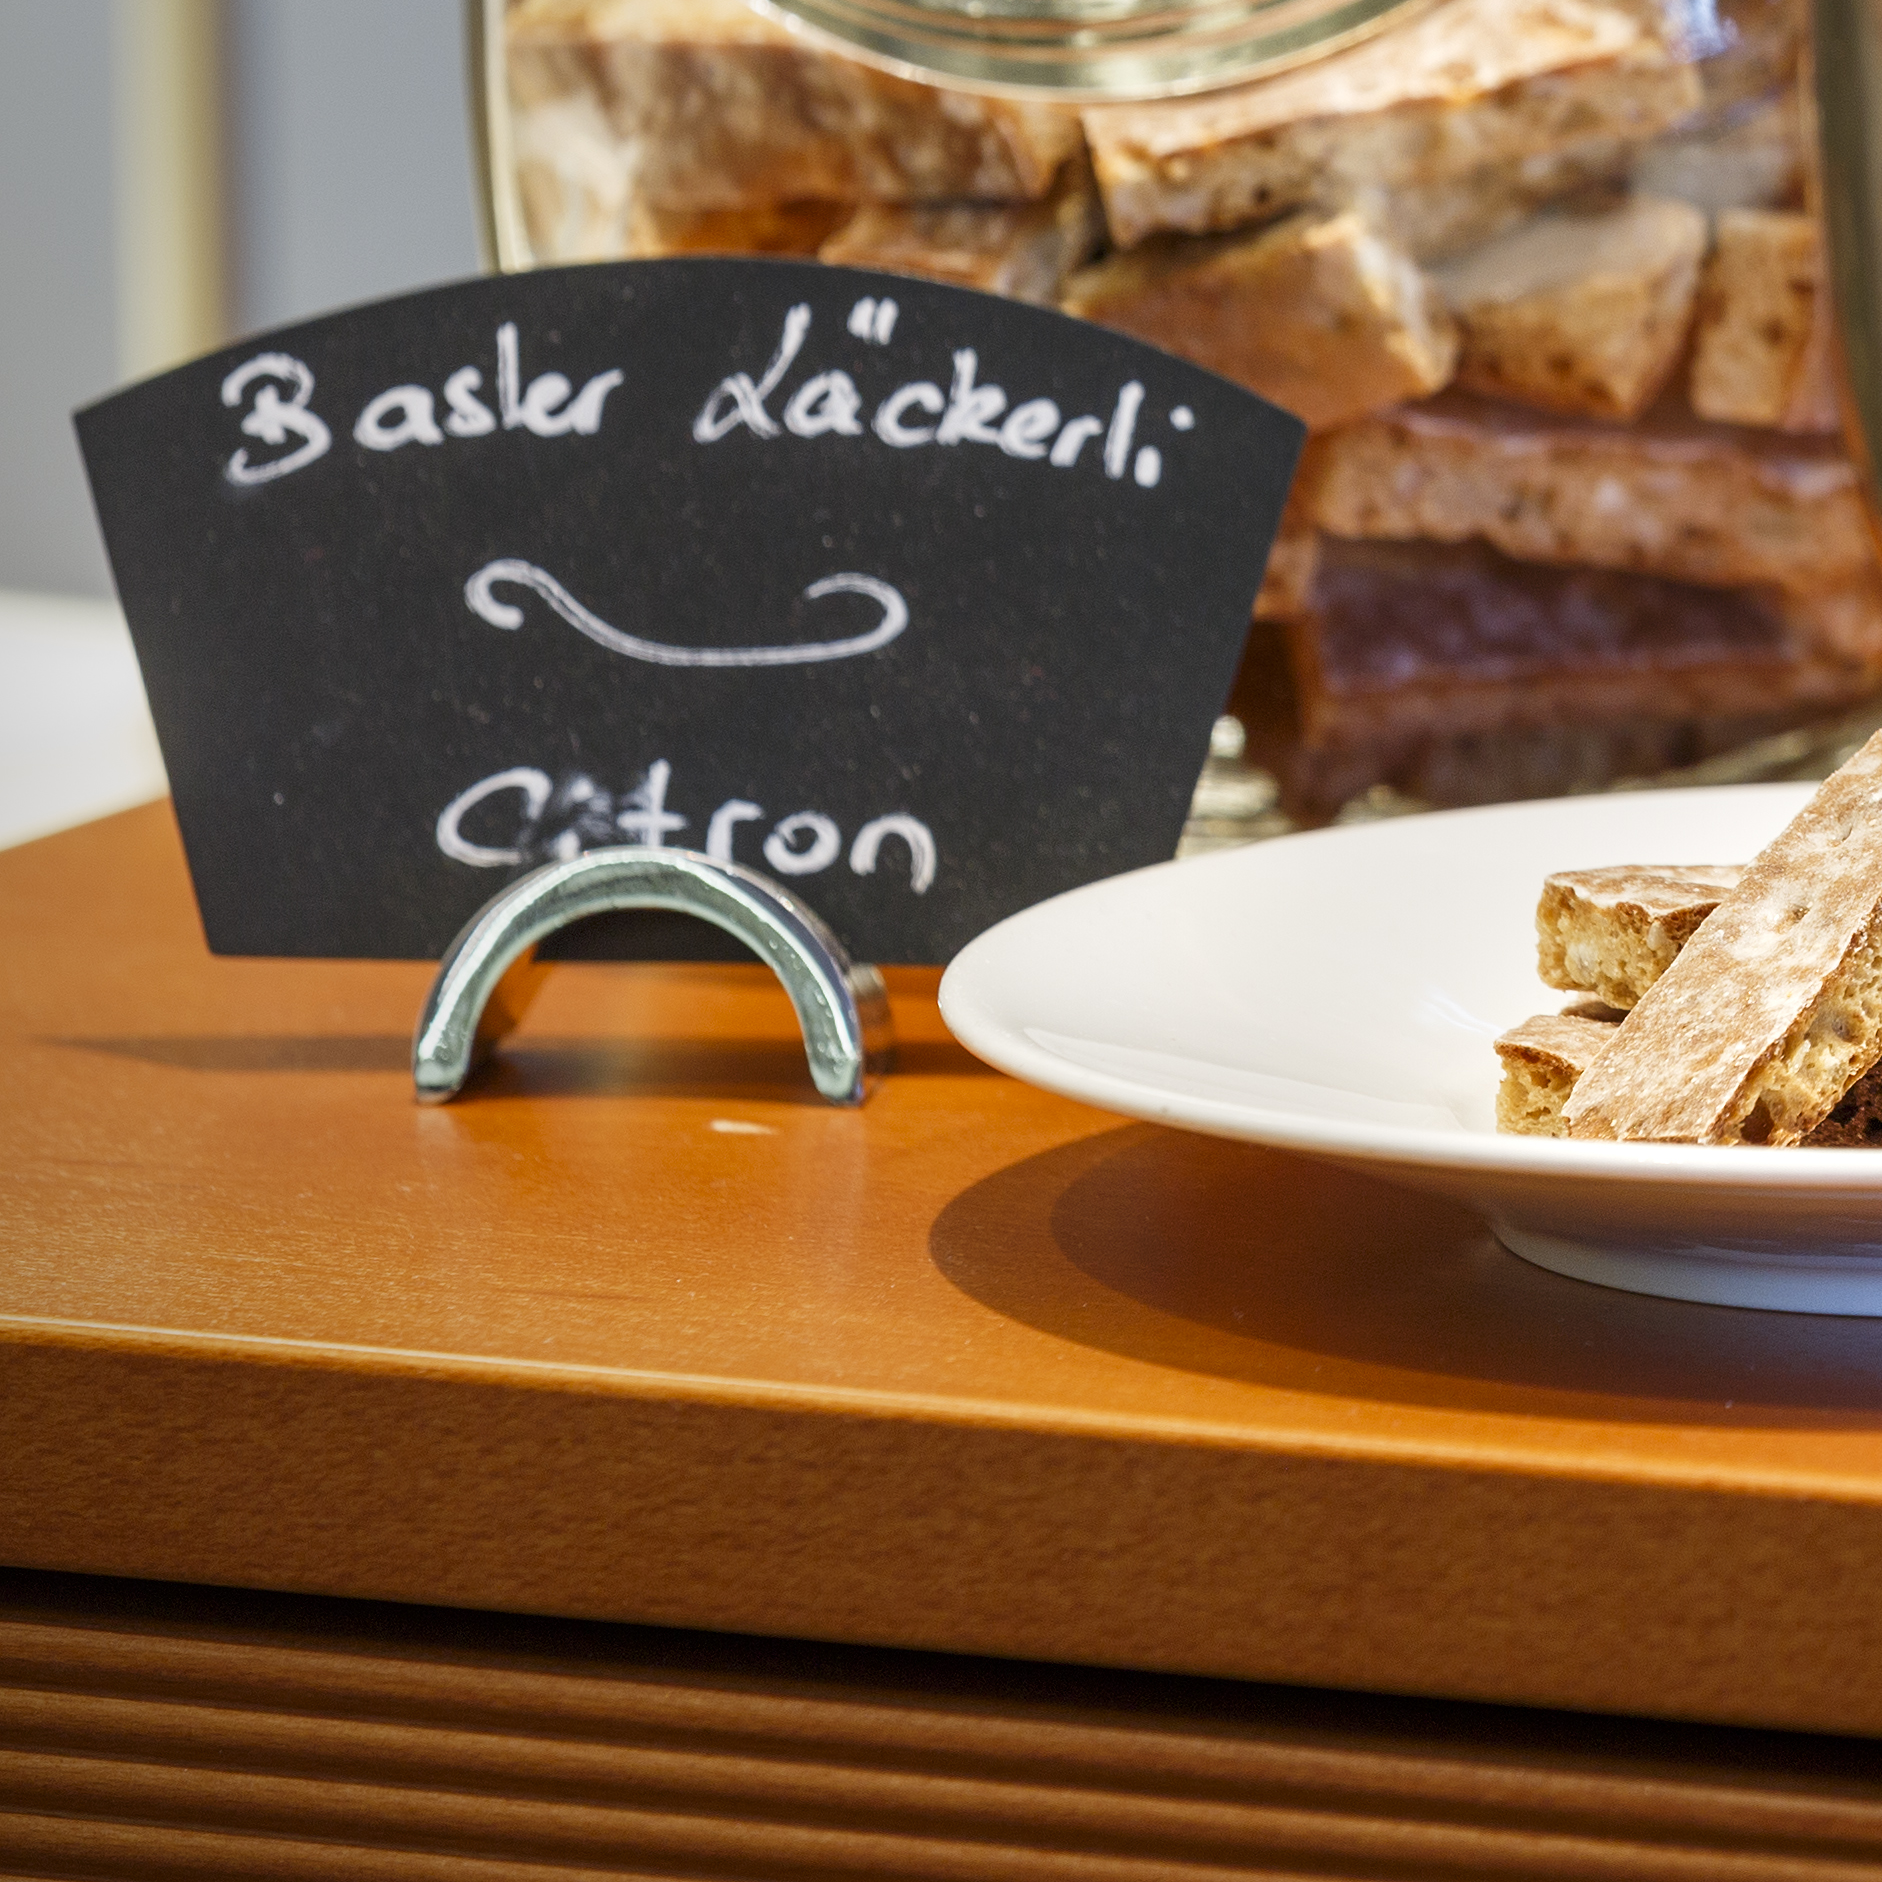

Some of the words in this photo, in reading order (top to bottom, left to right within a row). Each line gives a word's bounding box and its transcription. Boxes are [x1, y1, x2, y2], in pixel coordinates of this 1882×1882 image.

[220, 323, 623, 485] Basler
[694, 298, 1194, 487] Läckerli
[437, 760, 937, 893] Citron
